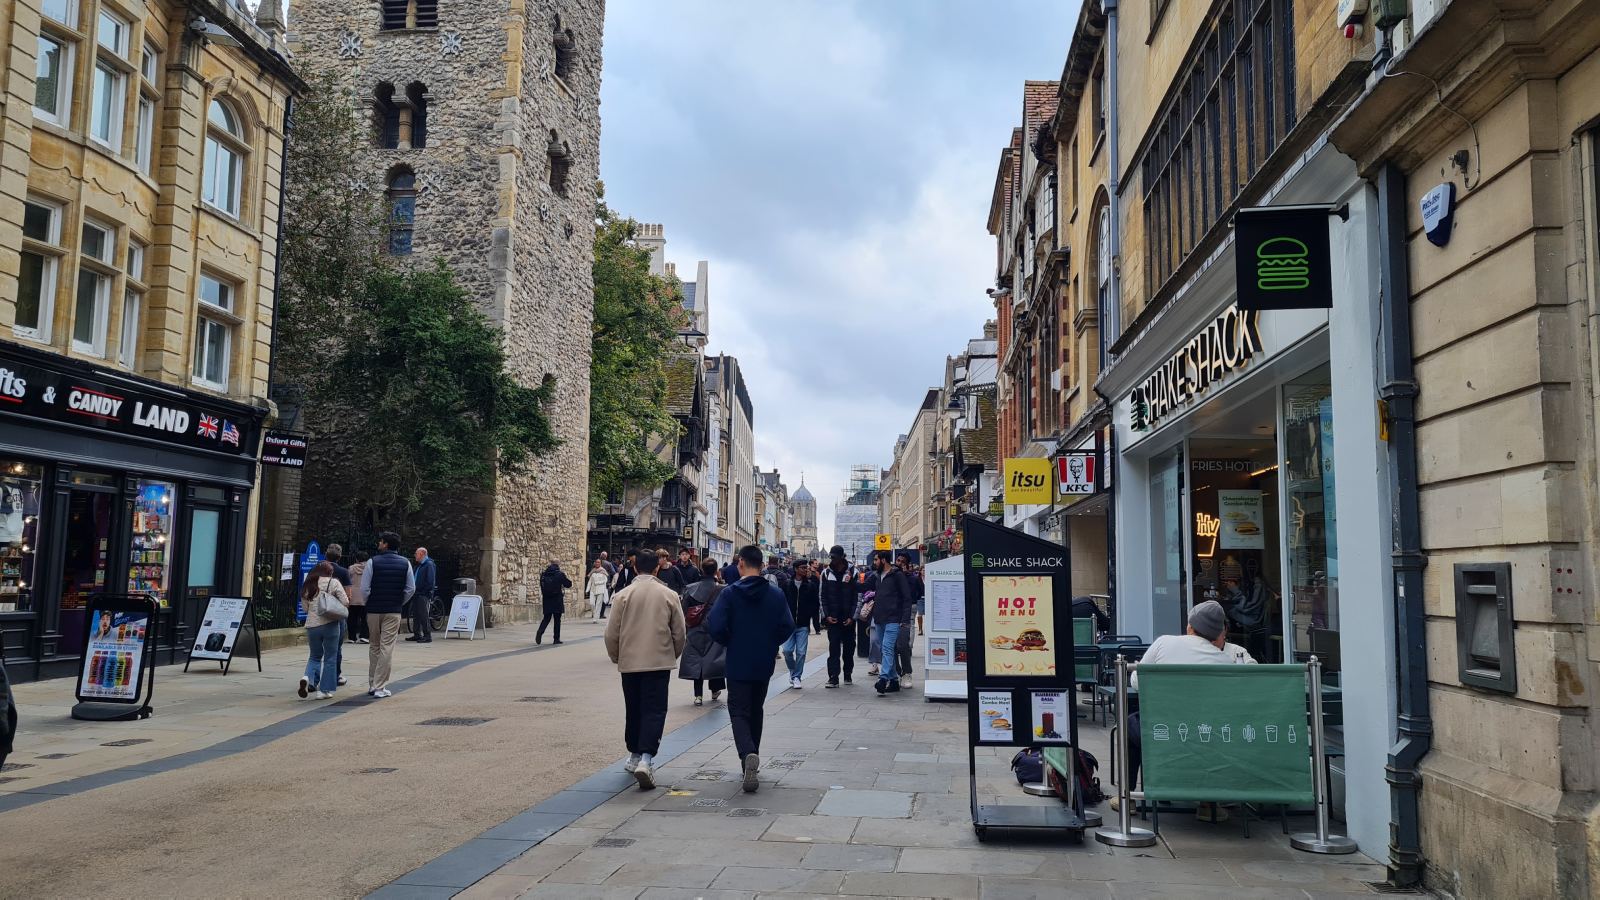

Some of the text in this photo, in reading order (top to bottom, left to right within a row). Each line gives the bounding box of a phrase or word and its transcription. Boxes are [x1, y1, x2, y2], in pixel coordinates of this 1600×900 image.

[1143, 304, 1255, 426] SHAKE SHACK
[42, 386, 57, 404] &
[68, 390, 123, 417] CANDY
[132, 401, 190, 434] LAND
[265, 436, 306, 448] Oxford Gifts
[281, 447, 288, 455] &
[280, 457, 303, 466] LAND
[1192, 461, 1222, 471] FRIES
[1225, 461, 1251, 471] HOT
[1011, 470, 1045, 487] itsu
[1065, 484, 1089, 492] KFC
[987, 557, 1063, 567] SHAKE SHACK
[997, 597, 1037, 608] HOT
